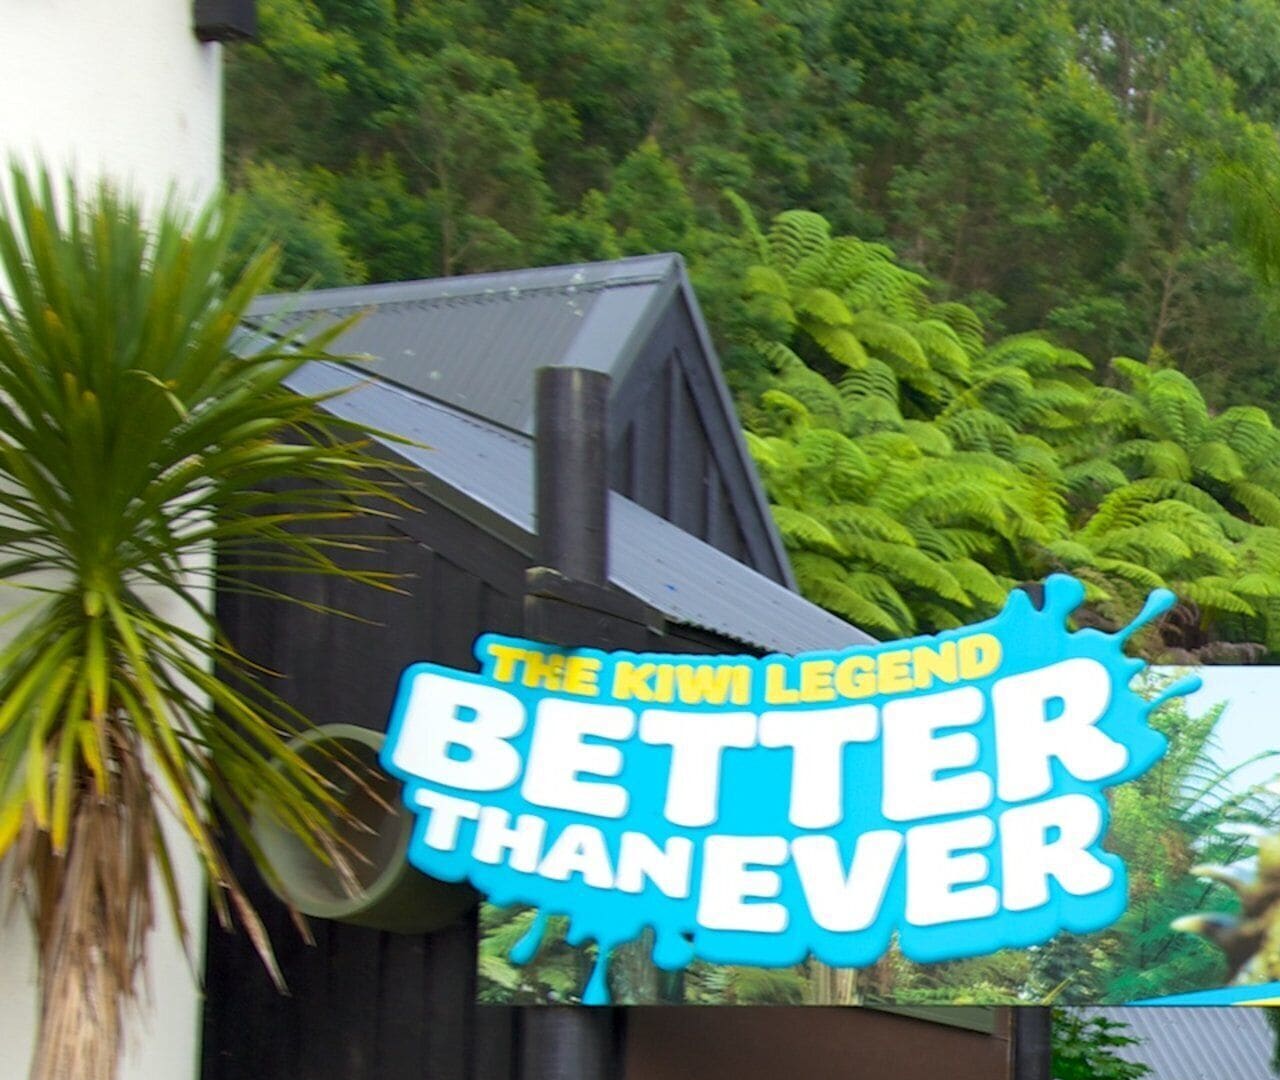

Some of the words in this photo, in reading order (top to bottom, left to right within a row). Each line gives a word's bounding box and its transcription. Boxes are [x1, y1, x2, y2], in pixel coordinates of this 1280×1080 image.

[392, 657, 1129, 828] BETTER
[487, 643, 600, 697] THE
[612, 660, 751, 706] KIWI
[763, 634, 1002, 705] LEGEND
[415, 789, 694, 900] THAN
[698, 794, 1113, 934] EVER
